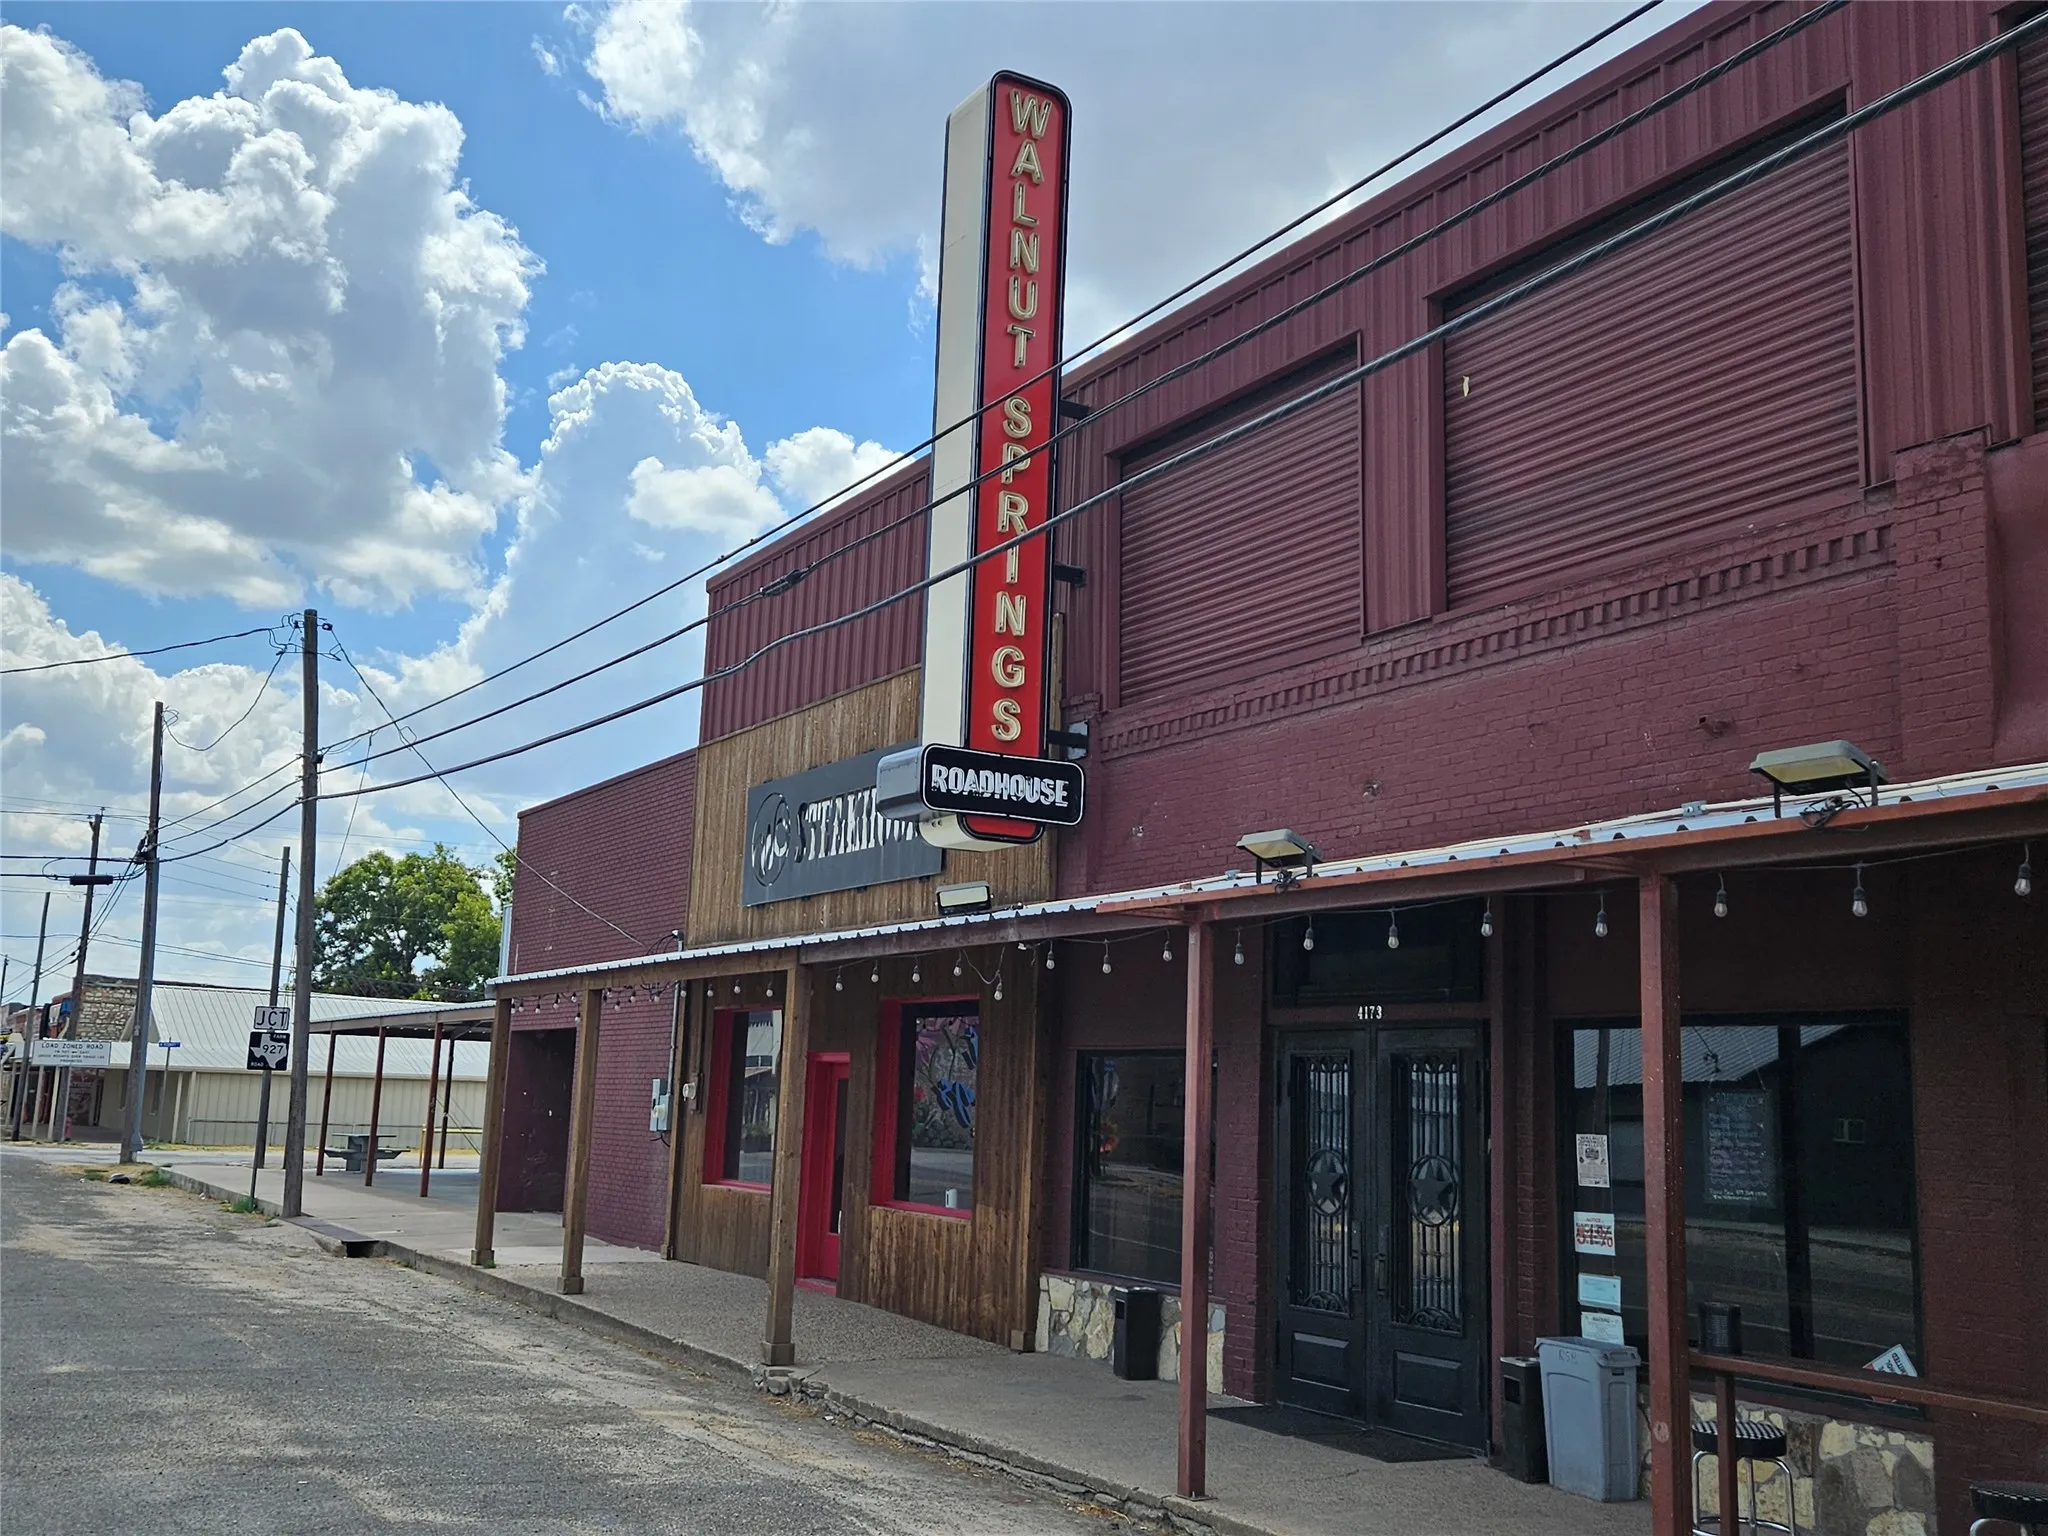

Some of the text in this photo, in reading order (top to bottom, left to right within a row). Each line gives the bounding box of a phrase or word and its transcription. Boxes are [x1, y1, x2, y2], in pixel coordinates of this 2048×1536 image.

[1007, 87, 1052, 369] WALNUT
[990, 395, 1032, 743] SPRINGS
[931, 763, 1069, 808] ROADHOUSE
[256, 1010, 288, 1027] JCT
[1357, 1005, 1382, 1020] 4173
[262, 1044, 284, 1054] 927
